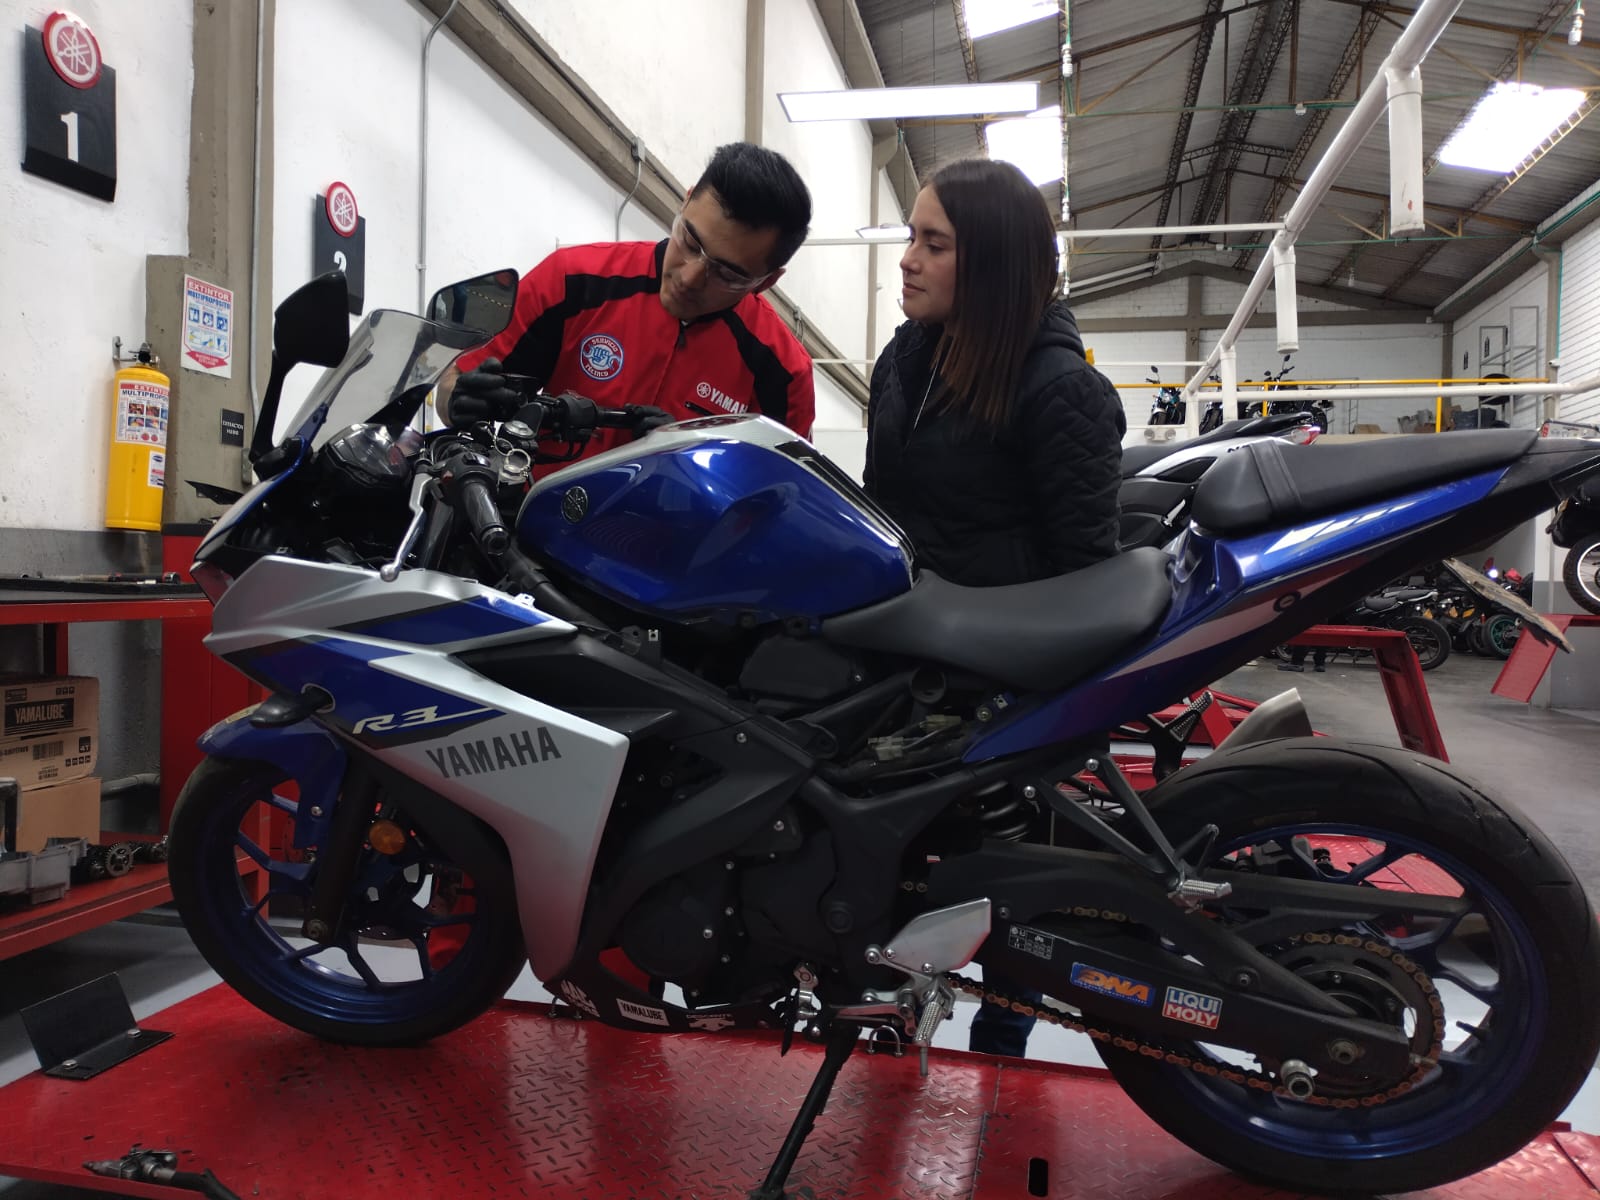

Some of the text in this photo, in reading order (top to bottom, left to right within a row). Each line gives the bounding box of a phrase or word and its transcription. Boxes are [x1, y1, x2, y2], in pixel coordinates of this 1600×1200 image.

[61, 112, 79, 163] 1
[188, 281, 230, 301] EXTINTOR
[710, 388, 749, 415] YAMAH
[15, 703, 65, 725] YAMALUBE
[352, 706, 446, 734] R3
[425, 726, 562, 778] YAMAHA
[1079, 967, 1150, 1001] DNA
[619, 1002, 664, 1021] YAMALUBE
[1168, 989, 1219, 1013] LIQUI
[1165, 1004, 1218, 1027] MOLY
